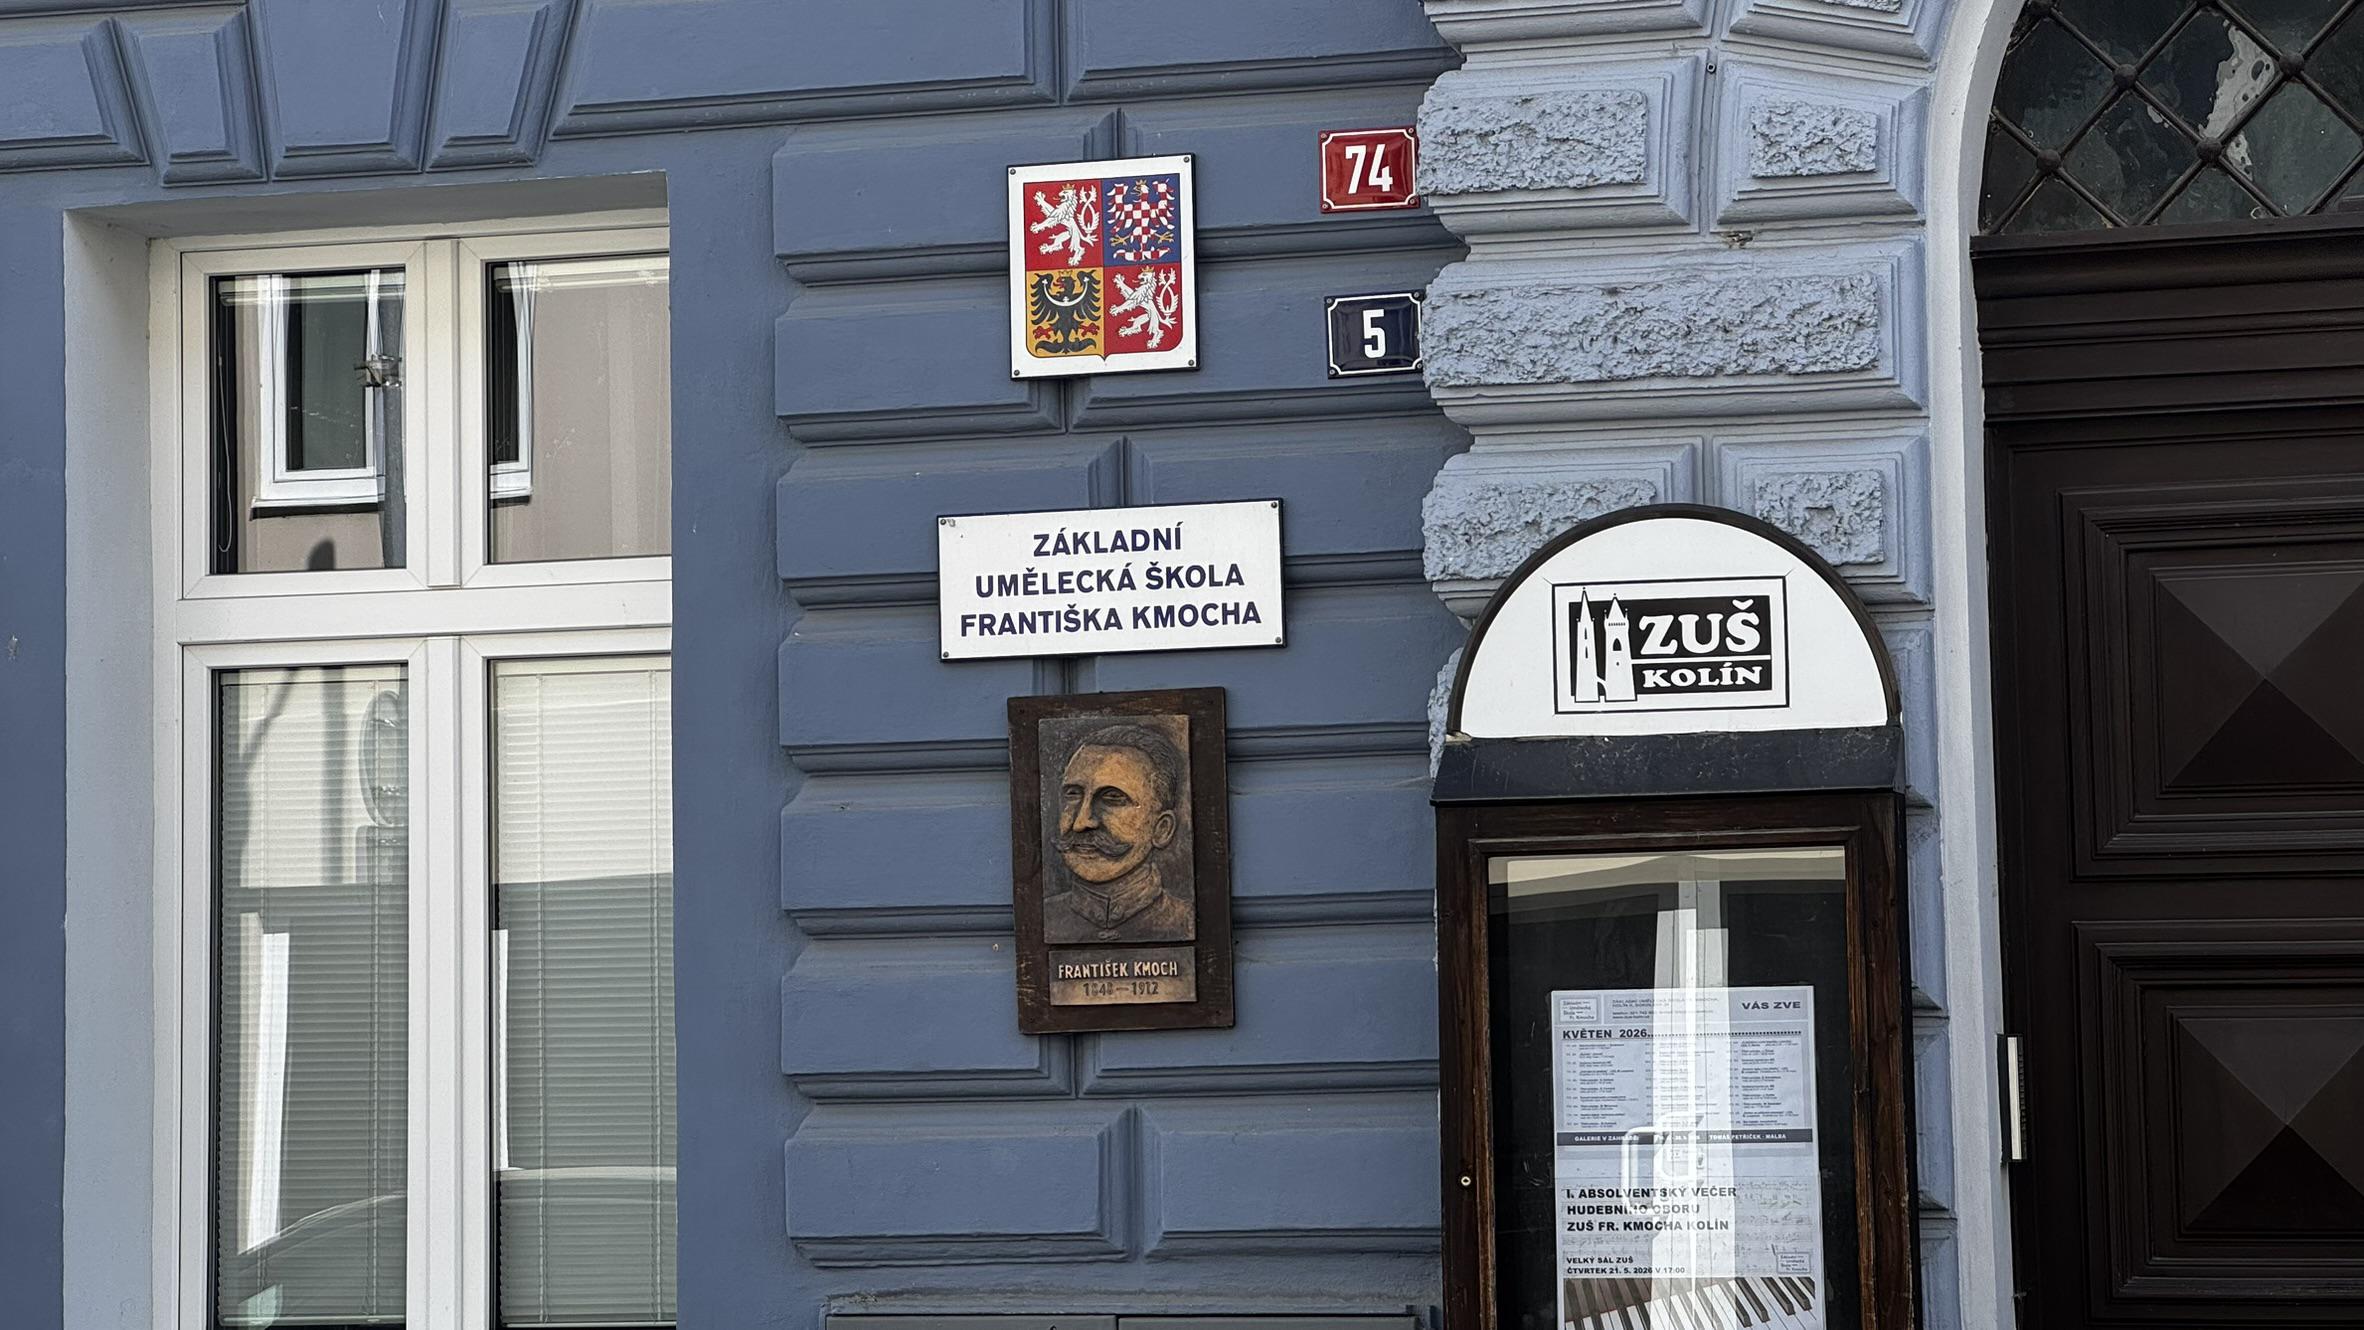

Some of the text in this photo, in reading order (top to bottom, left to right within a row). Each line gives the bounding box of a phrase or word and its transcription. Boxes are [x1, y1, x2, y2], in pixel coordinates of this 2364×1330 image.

[1345, 144, 1393, 194] 74
[1362, 309, 1386, 358] 5
[1033, 521, 1184, 557] ZÁKLADNÍ
[975, 561, 1244, 598] UMĚLECKÁ ŠKOLA
[960, 601, 1262, 637] FRANTIŠKA KMOCHA
[1638, 599, 1761, 655] ZUŠ
[1642, 662, 1763, 688] KOLÍN
[1058, 959, 1178, 979] FRANTIŠEK KMOCH
[1741, 1000, 1801, 1010] VÁS ZVE
[1562, 1028, 1612, 1039] KVĚTEN
[1578, 1185, 1687, 1199] ABSOLVENTSKÝ
[1691, 1185, 1737, 1198] VEČER
[1652, 1203, 1700, 1214] OBORU
[1567, 1218, 1729, 1232] ZUŠ FR. KMOCHA KOLÍN
[1566, 1255, 1634, 1264] VELKÝ SÁL ZUŠ
[1567, 1266, 1607, 1274] ČTVRTEK
[1633, 1266, 1653, 1274] 2026
[1663, 1266, 1686, 1274] 1700
